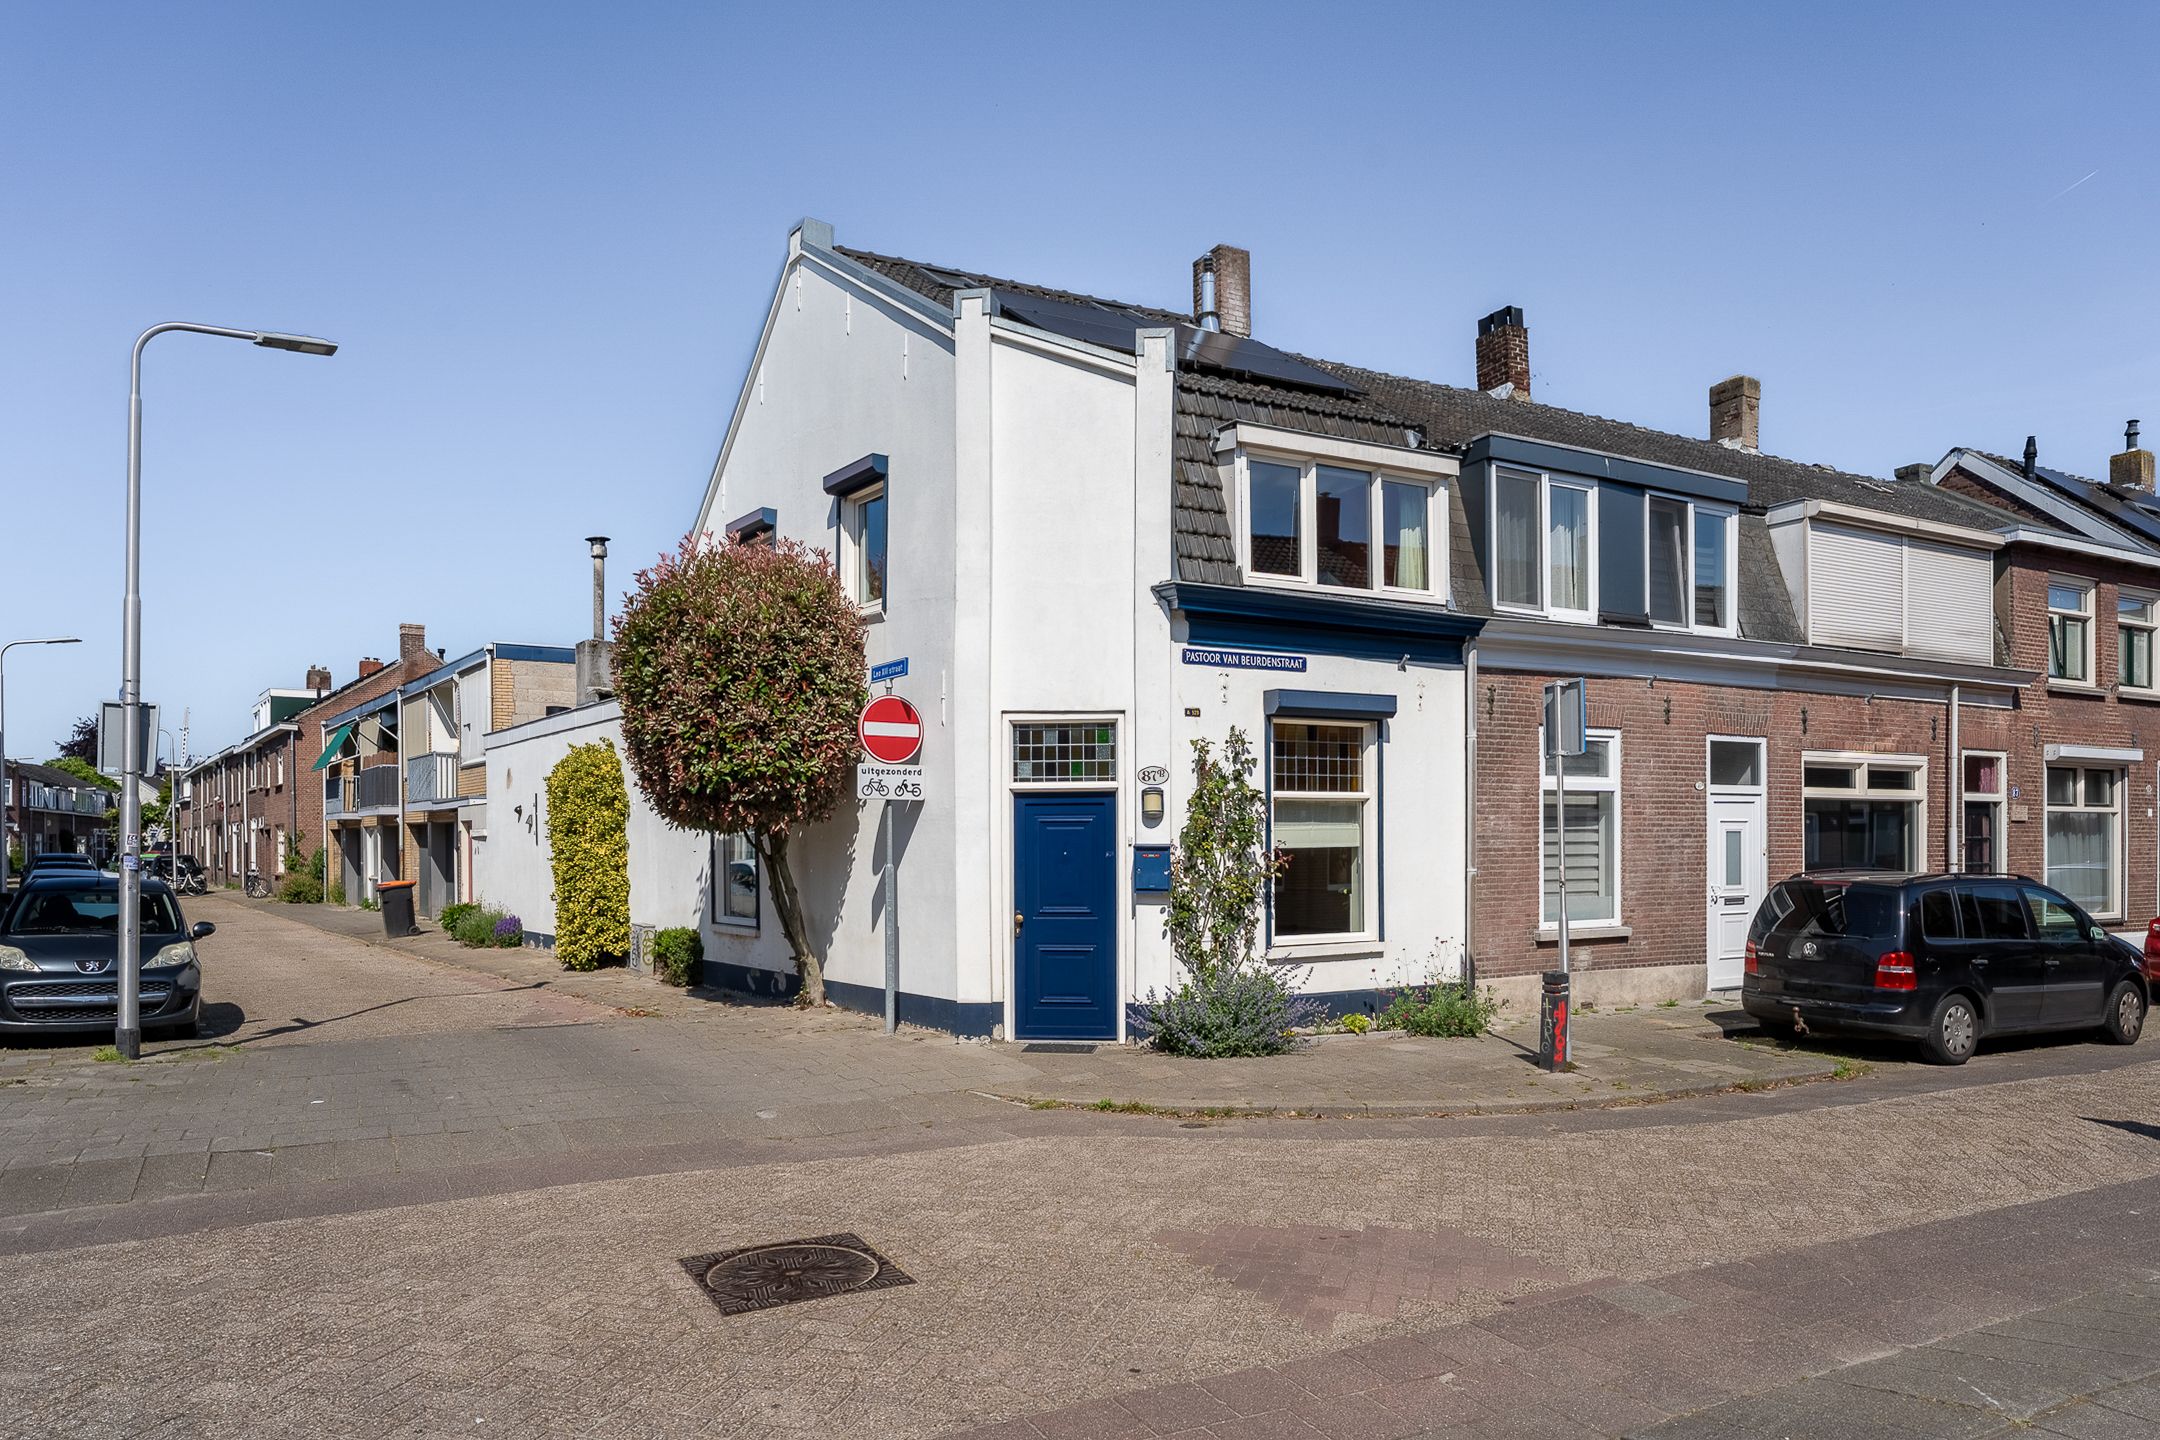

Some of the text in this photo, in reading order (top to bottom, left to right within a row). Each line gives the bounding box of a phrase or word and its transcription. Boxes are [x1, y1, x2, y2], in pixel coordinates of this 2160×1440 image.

[1186, 651, 1304, 669] PASTOOR VAN BEURDENSTRAAT
[889, 664, 903, 675] straat
[861, 767, 922, 777] uitgezonderd
